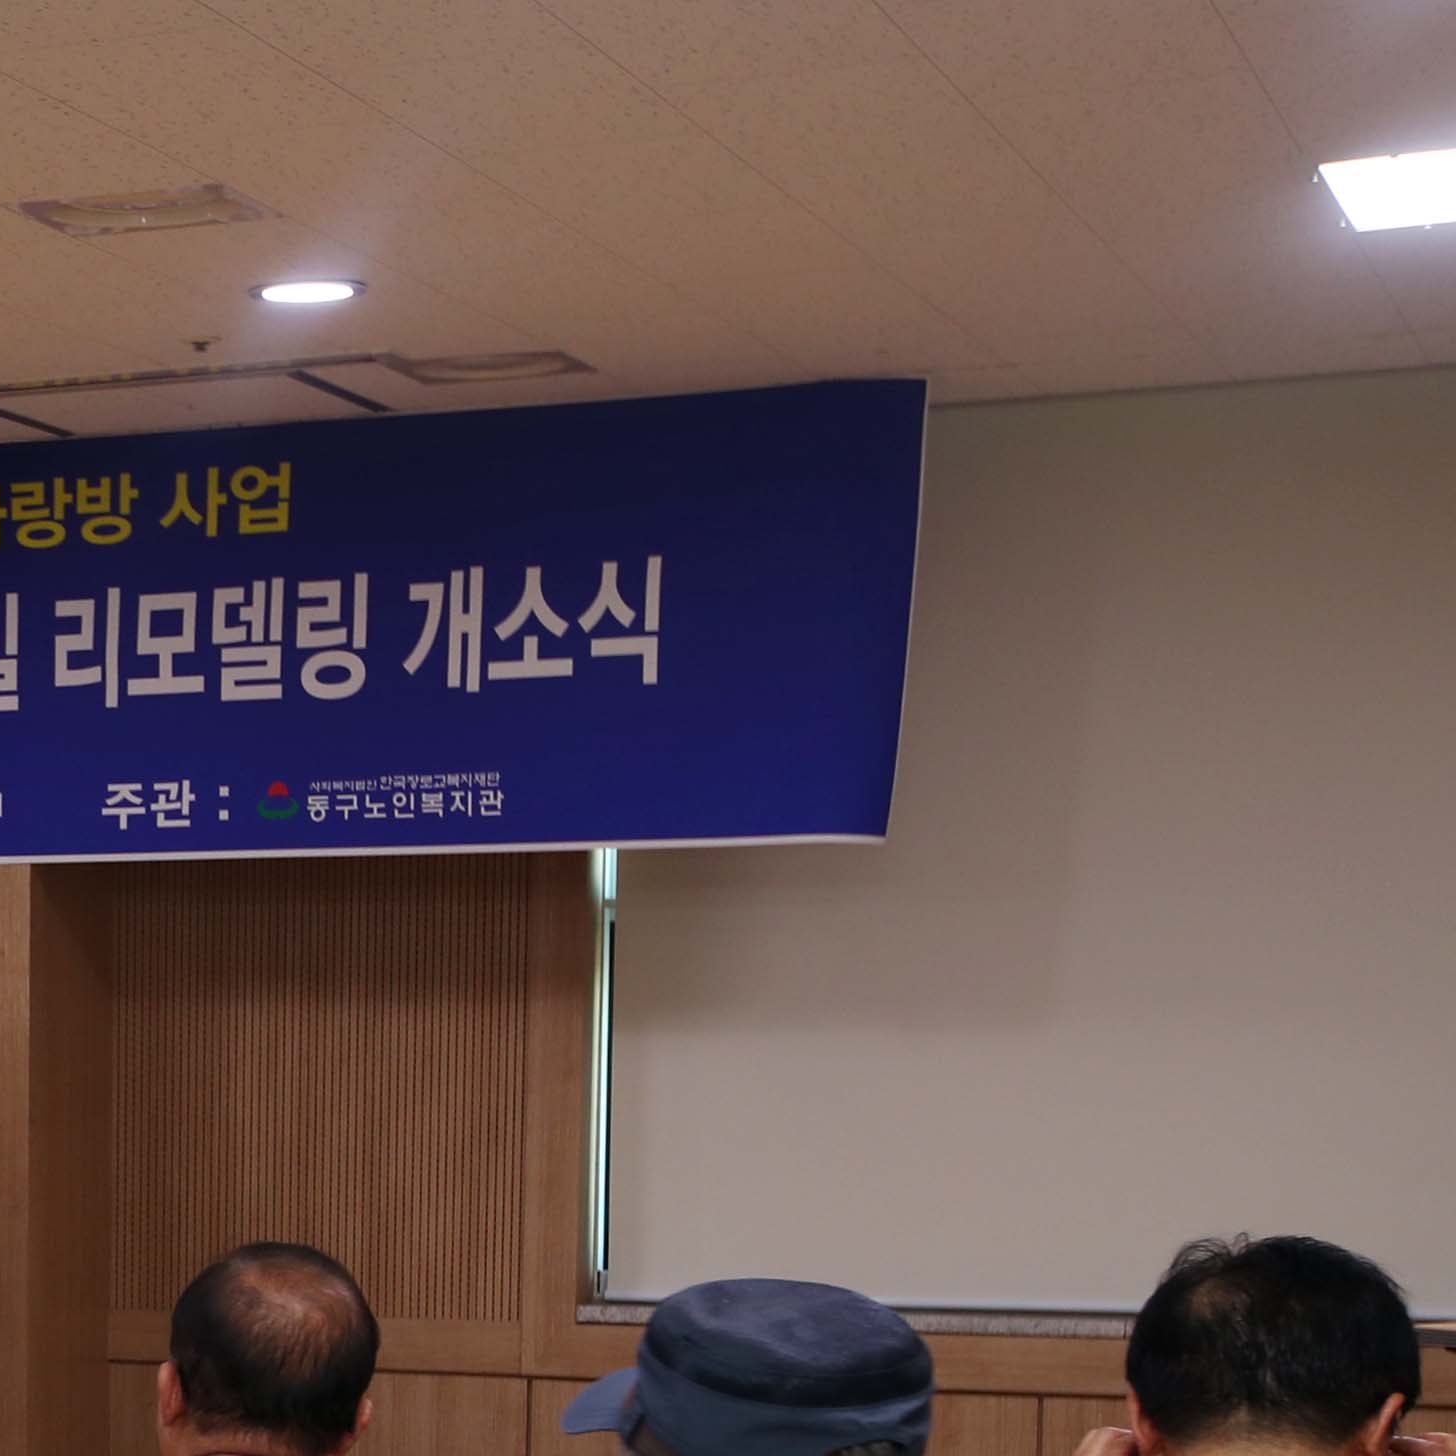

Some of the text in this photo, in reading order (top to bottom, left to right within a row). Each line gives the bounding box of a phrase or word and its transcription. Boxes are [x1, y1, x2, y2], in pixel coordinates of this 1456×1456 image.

[159, 462, 291, 537] 사업
[54, 572, 368, 709] 리모델링
[402, 555, 662, 693] 개소식
[101, 779, 196, 830] 주관
[306, 790, 505, 823] 동구노인복지관
